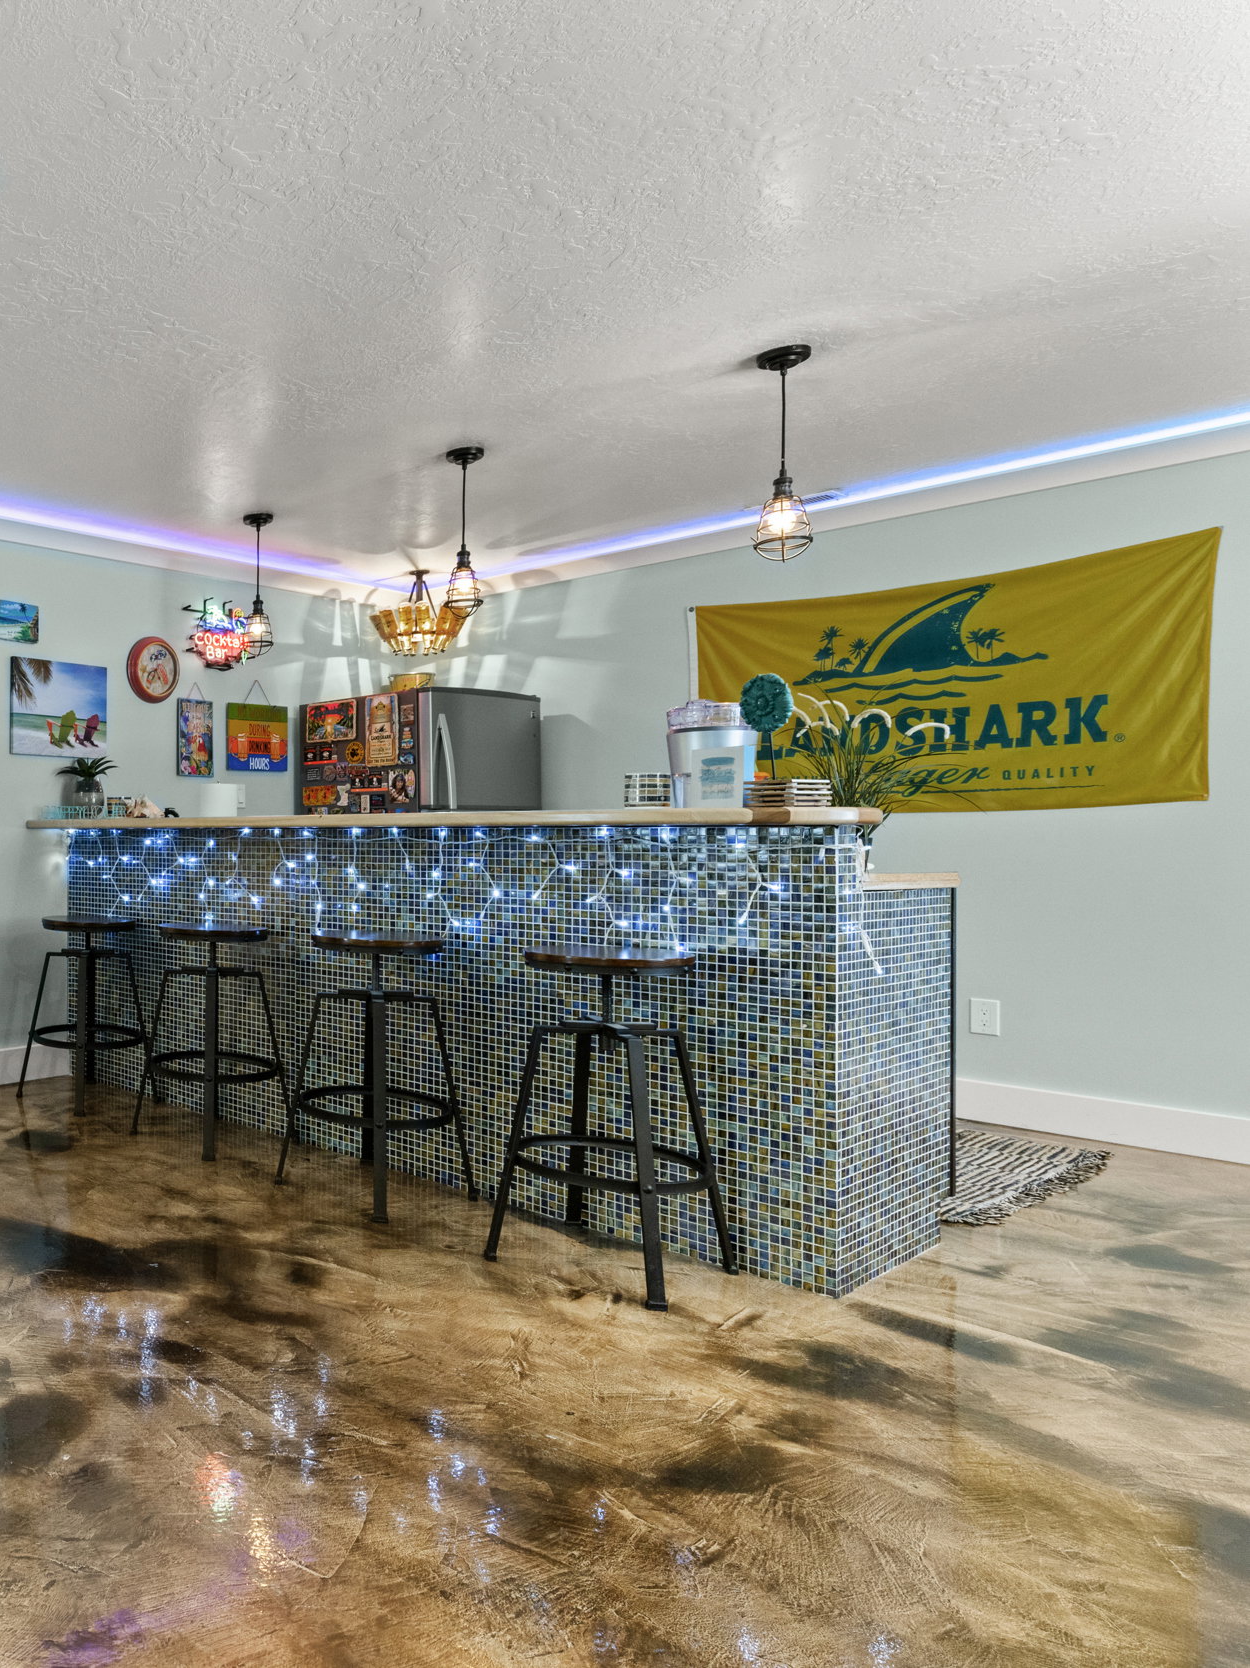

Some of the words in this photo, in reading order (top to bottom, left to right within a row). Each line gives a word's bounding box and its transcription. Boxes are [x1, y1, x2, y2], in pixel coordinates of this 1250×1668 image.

[206, 646, 227, 659] Bar
[249, 723, 270, 737] DURING
[757, 694, 1108, 760] LANDSHARK
[249, 740, 270, 753] DRINKING
[250, 757, 270, 770] HOURS
[1002, 765, 1096, 781] QUALITY
